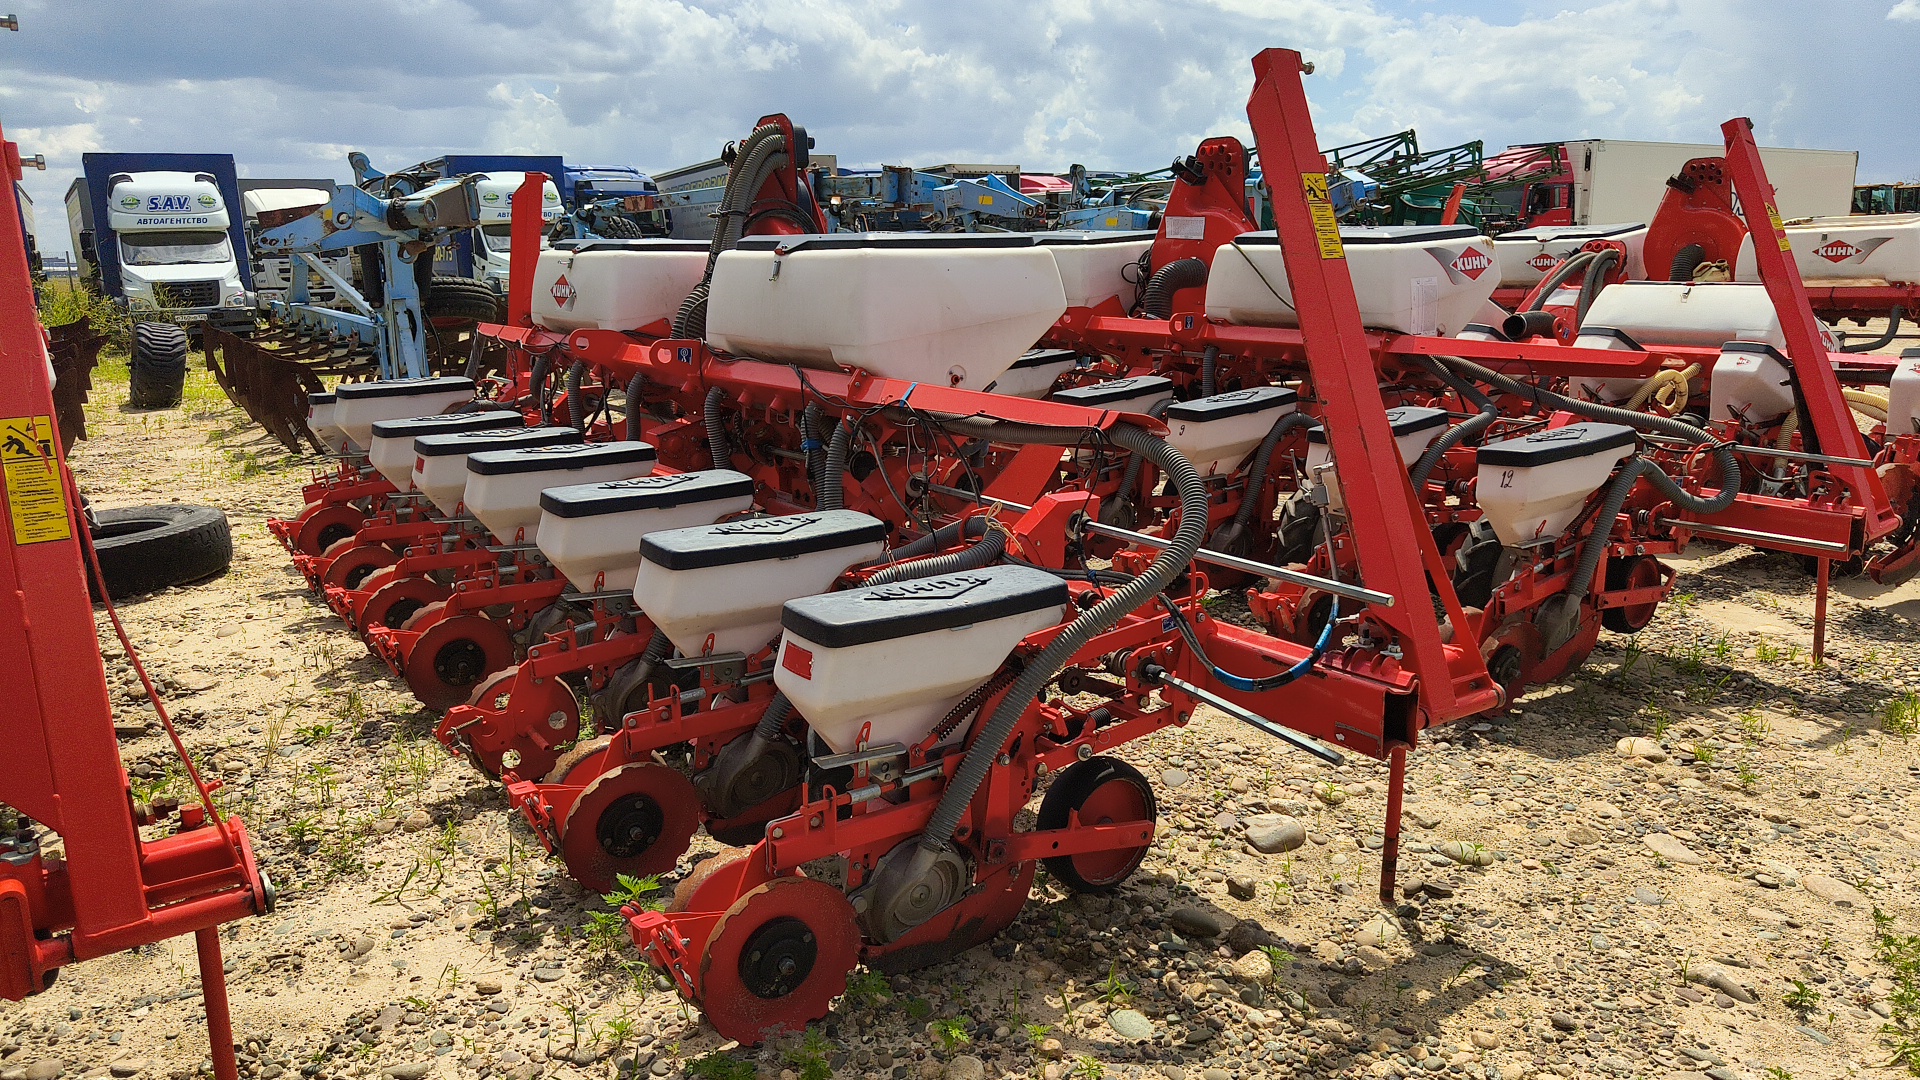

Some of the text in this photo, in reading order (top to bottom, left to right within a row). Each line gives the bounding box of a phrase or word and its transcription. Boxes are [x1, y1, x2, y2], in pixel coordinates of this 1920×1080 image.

[147, 195, 191, 212] S.A.V.
[137, 217, 208, 225] АВТОАГЕНТСТВО
[1818, 247, 1856, 256] KUHN
[1455, 255, 1489, 271] KUHN
[1530, 259, 1557, 267] KUHN
[1500, 470, 1514, 488] 12
